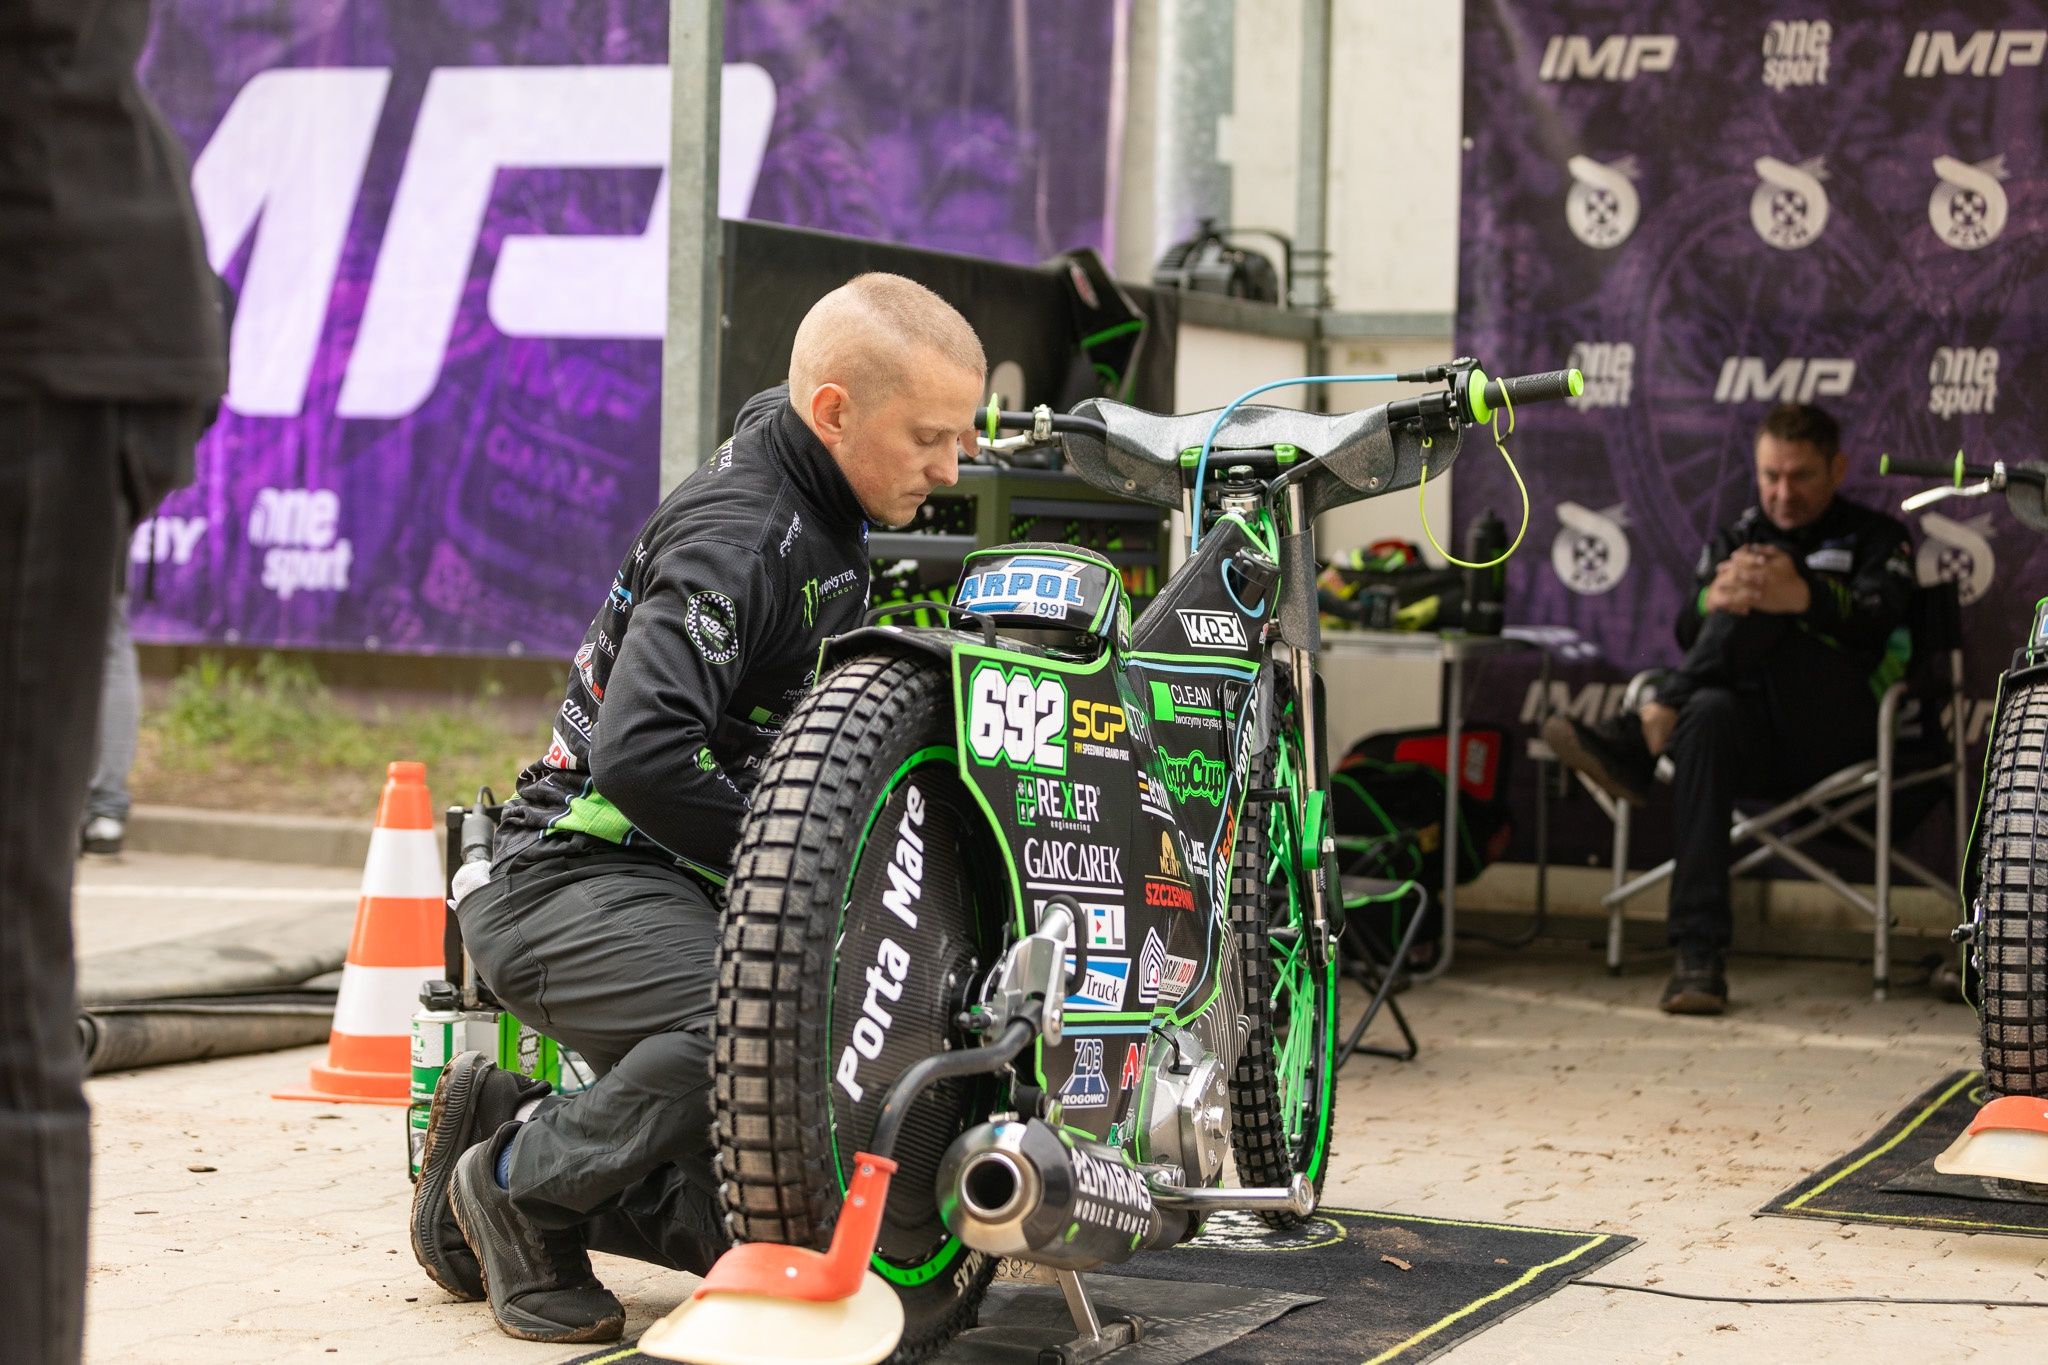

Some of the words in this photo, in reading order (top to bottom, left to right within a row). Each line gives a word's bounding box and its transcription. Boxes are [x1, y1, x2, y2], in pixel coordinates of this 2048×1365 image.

[1540, 36, 1678, 81] IMP
[1905, 31, 2046, 77] IMP
[1763, 57, 1830, 93] sport
[190, 63, 777, 417] MP
[1715, 357, 1856, 403] IMP
[1930, 383, 1998, 420] sport
[262, 543, 354, 598] sport
[959, 572, 1082, 604] ARPOL
[1033, 601, 1065, 617] 1991
[1182, 614, 1246, 646] KAREX
[1171, 684, 1212, 708] CLEAN
[968, 667, 1066, 768] 692
[1073, 699, 1126, 743] SGP
[1036, 778, 1099, 822] REXER
[1050, 821, 1091, 833] engineering
[1024, 838, 1123, 884] GARCAREK
[836, 937, 911, 1103] Porta
[881, 784, 925, 930] Mare
[1086, 974, 1120, 1003] Truck
[1061, 1093, 1105, 1105] ROGOWO
[1073, 1198, 1115, 1228] MOBILE
[1115, 1210, 1150, 1237] HOMES
[996, 1258, 1036, 1280] 692
